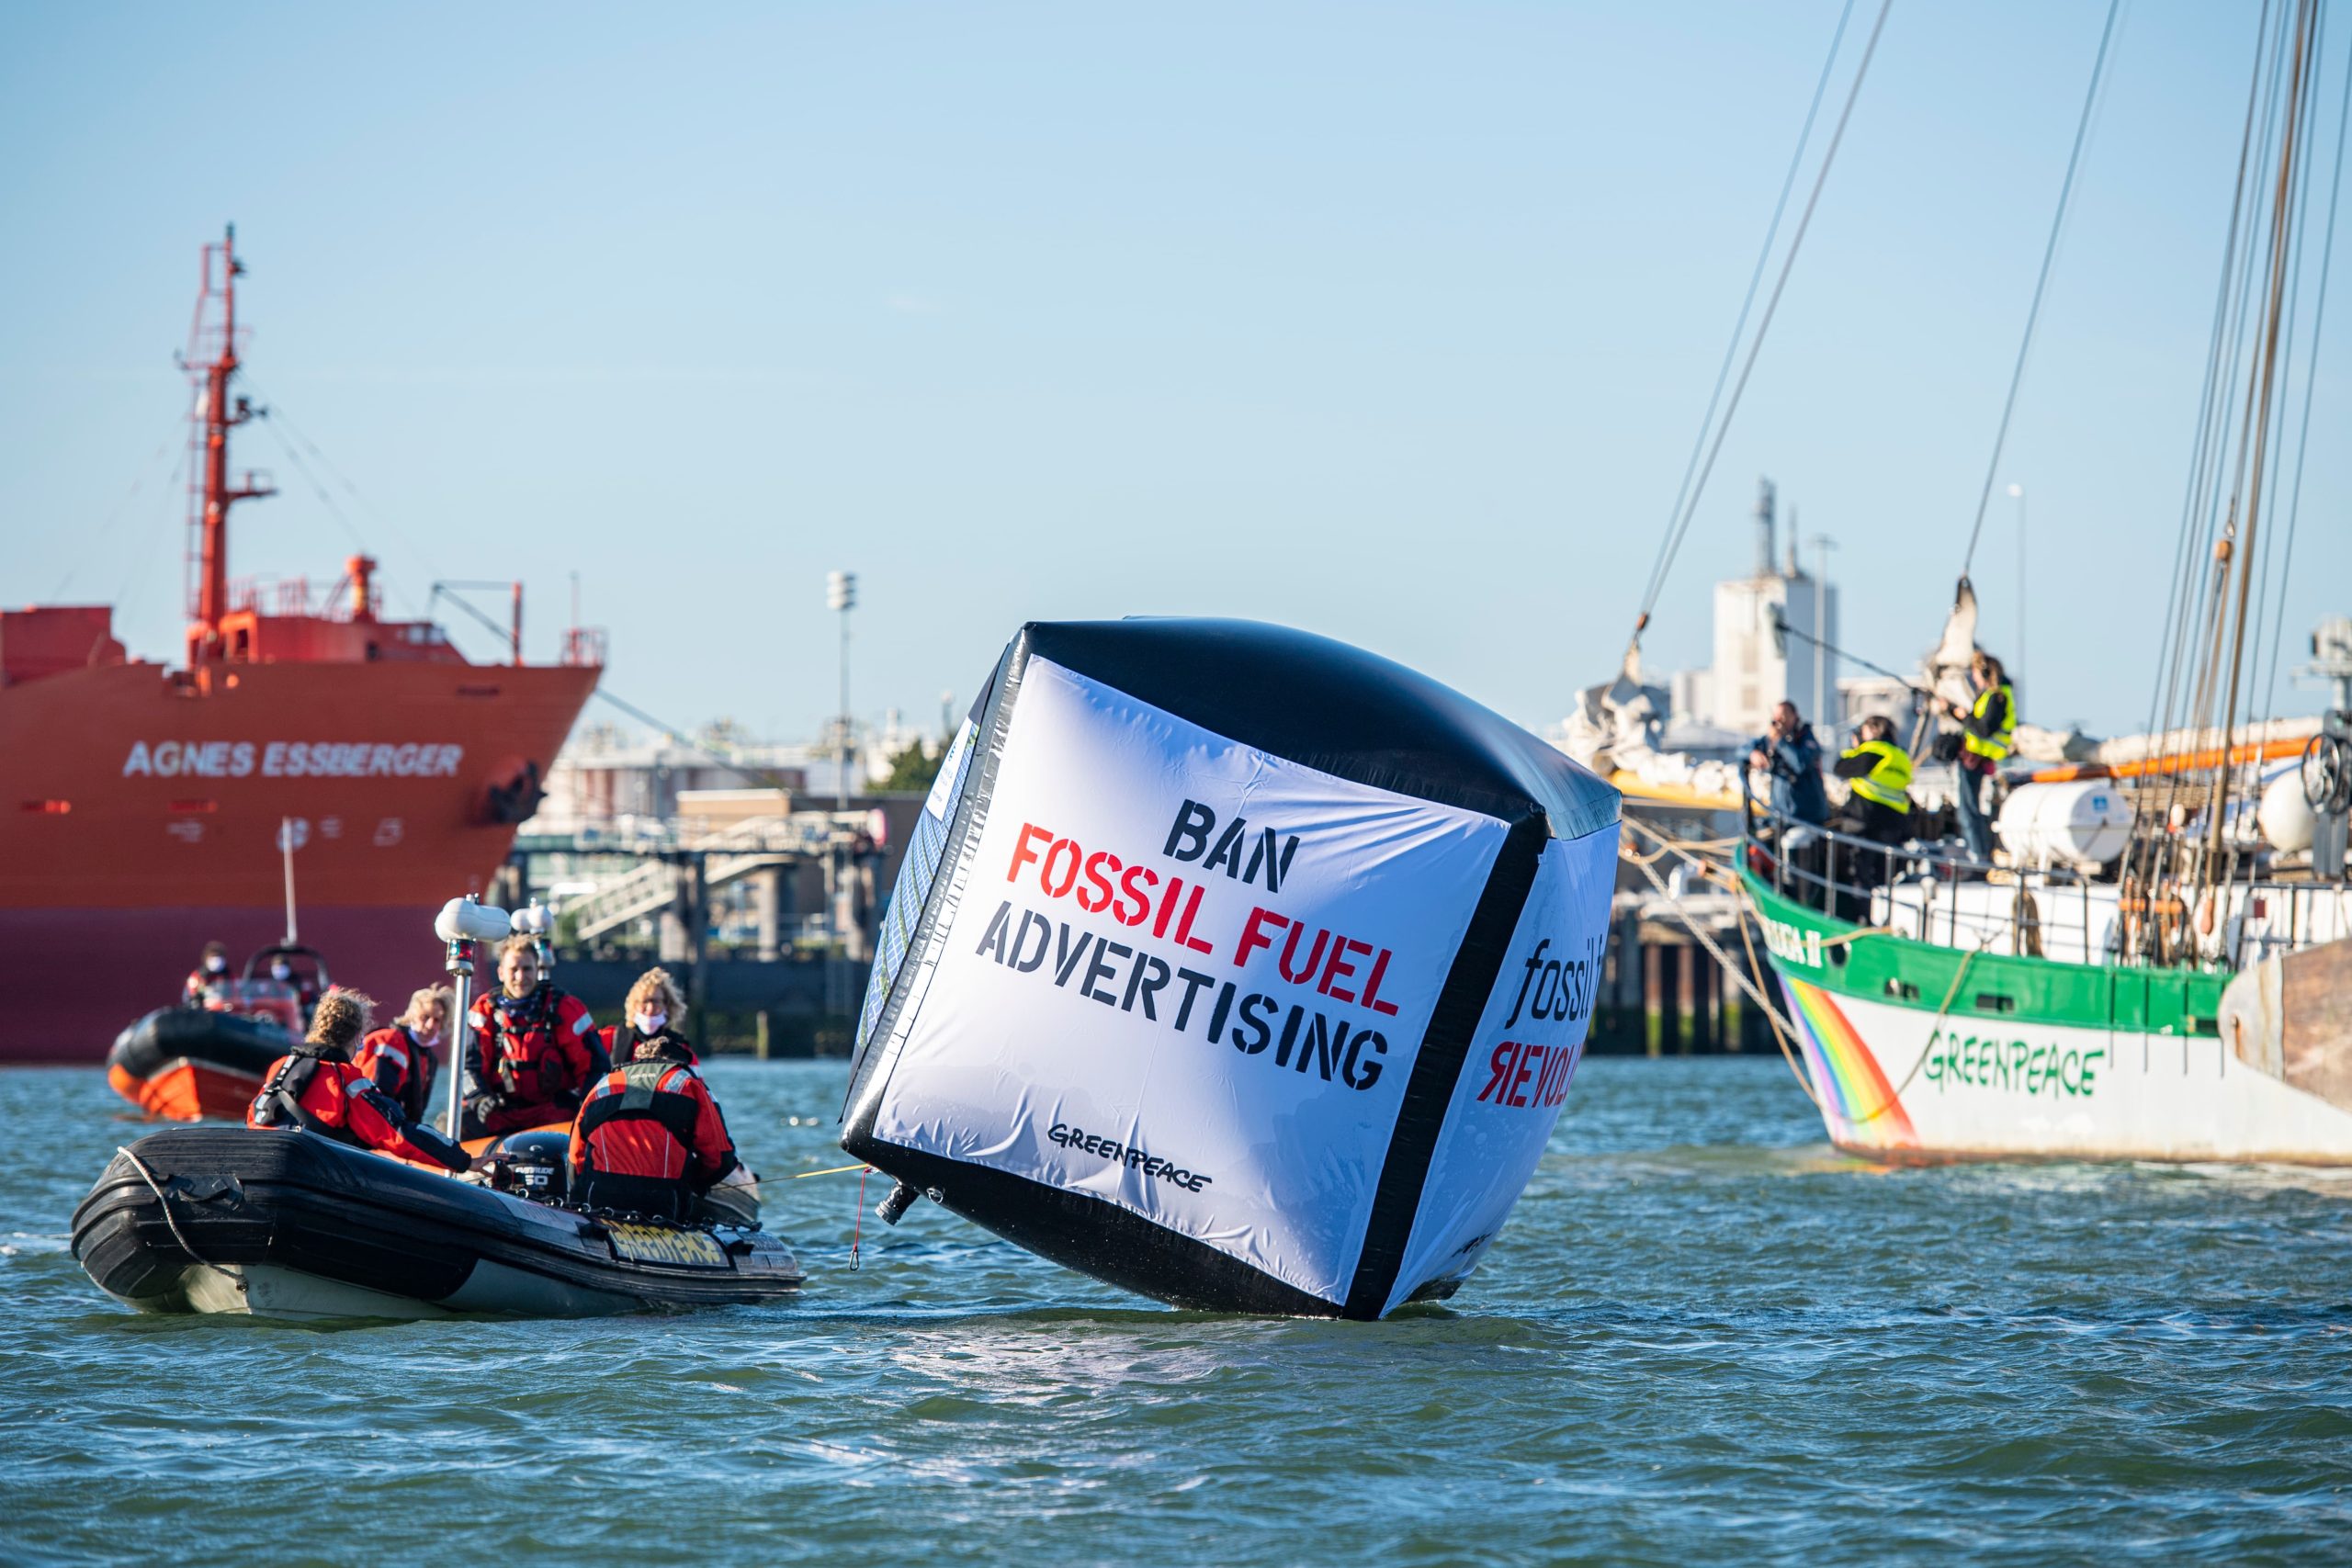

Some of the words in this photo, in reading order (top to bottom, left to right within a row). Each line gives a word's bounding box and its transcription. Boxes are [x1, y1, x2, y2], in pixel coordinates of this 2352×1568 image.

[122, 740, 255, 778] AGNES
[261, 741, 463, 778] ESSBERGER
[1163, 798, 1300, 894] BAN
[1007, 822, 1215, 956] FOSSIL
[1233, 906, 1400, 1018] FUEL
[976, 900, 1388, 1091] ADVERTISING
[1504, 937, 1595, 1030] fossil
[1924, 1029, 2105, 1100] GREENPEACE
[1047, 1123, 1213, 1193] GREENPEACE
